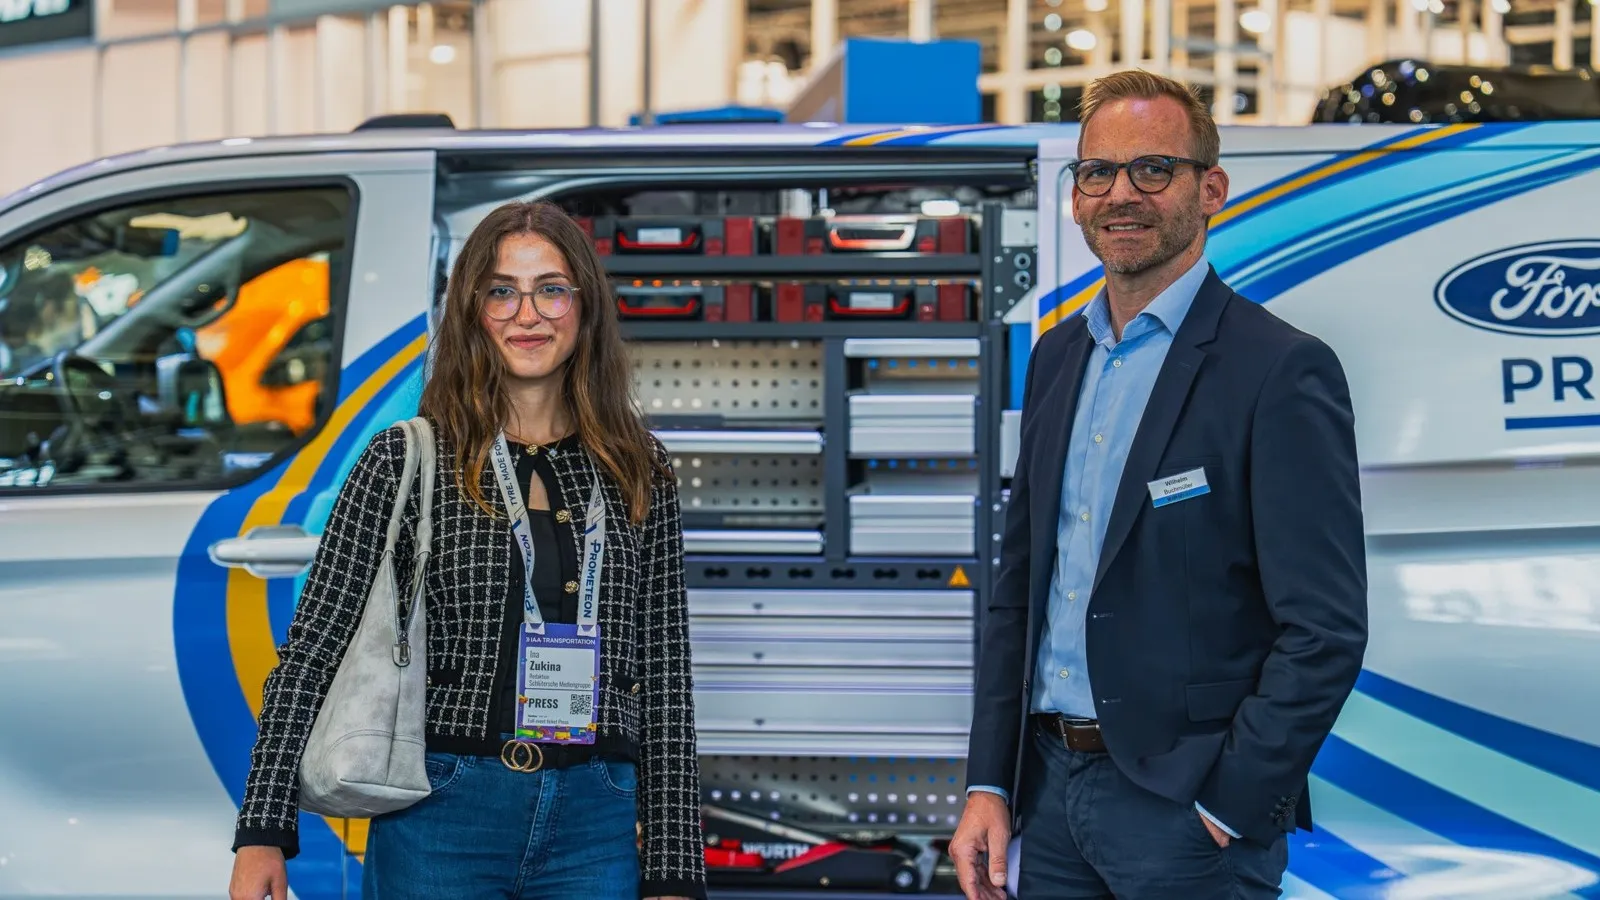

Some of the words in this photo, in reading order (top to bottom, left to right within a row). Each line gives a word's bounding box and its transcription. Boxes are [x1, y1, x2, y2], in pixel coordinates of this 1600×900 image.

[1490, 256, 1600, 320] For
[497, 457, 511, 481] MADE
[1165, 476, 1188, 486] Wilhelm
[505, 482, 518, 506] TYRE.
[1163, 483, 1193, 495] Buchmüller
[583, 538, 601, 618] PROMETEON
[543, 637, 595, 645] TRANSPORTATION
[530, 650, 540, 658] Ina
[529, 661, 561, 672] Zukina
[528, 698, 559, 709] PRESS
